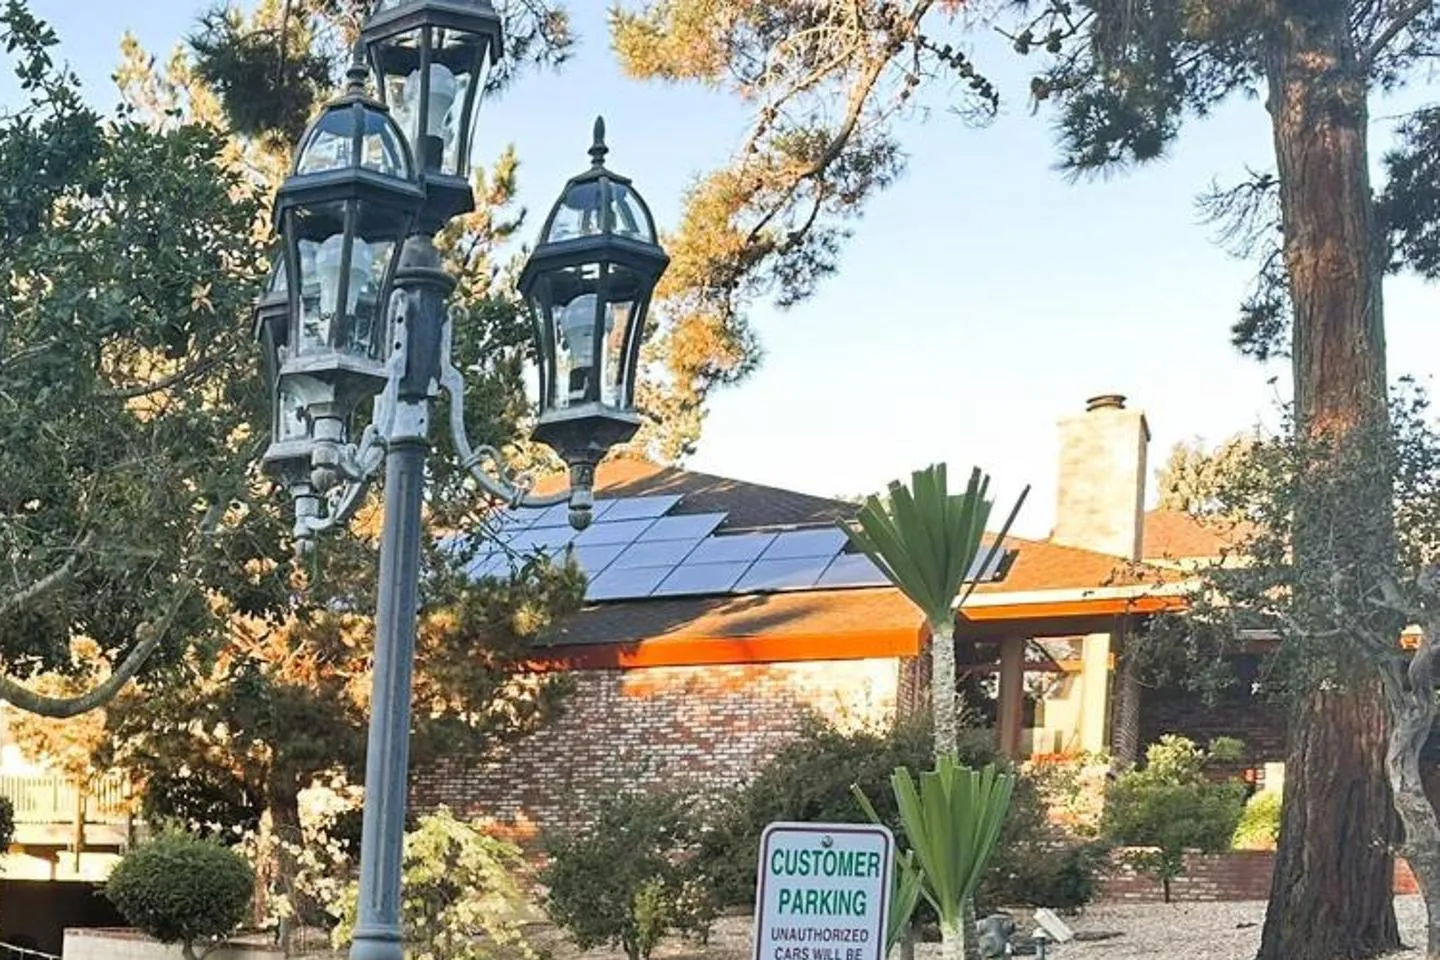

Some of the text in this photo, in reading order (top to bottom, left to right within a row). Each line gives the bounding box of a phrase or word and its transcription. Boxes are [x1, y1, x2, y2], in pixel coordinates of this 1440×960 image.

[771, 849, 880, 878] CUSTOMER
[779, 888, 867, 916] PARKING
[771, 928, 869, 943] UNAUTHORIZED
[774, 947, 809, 960] CARS
